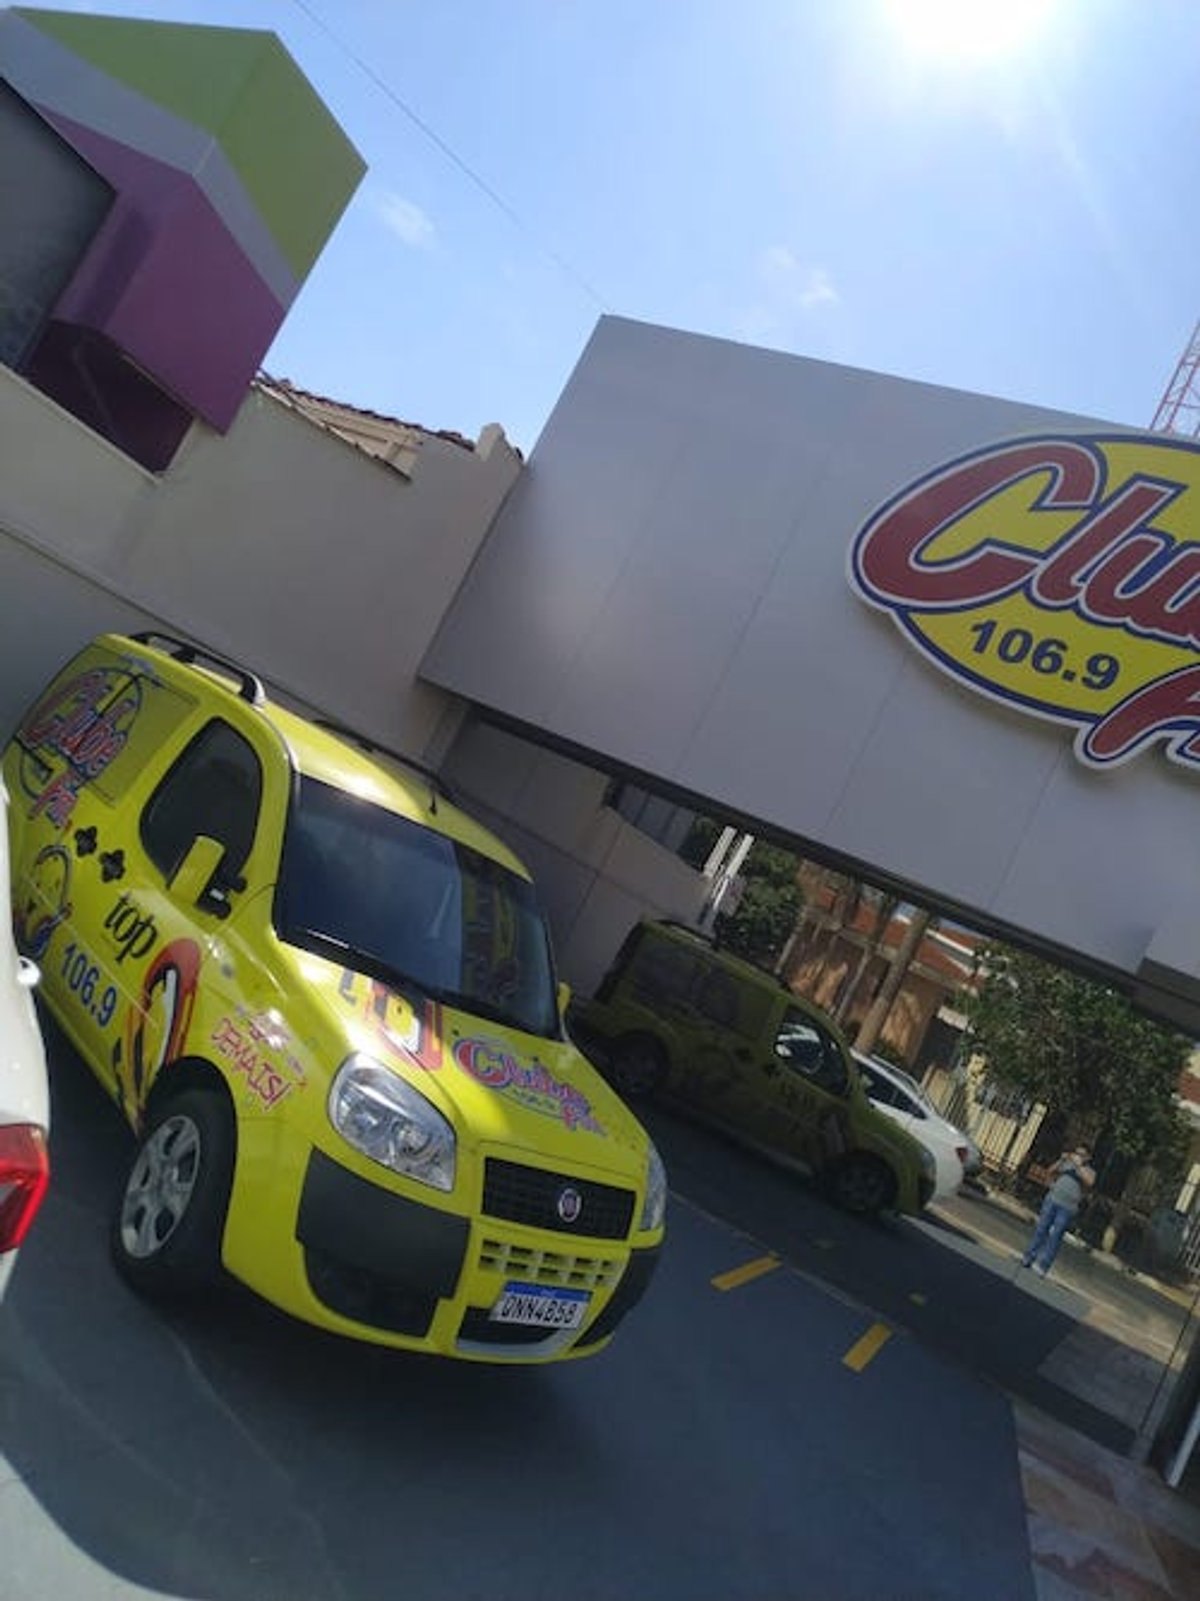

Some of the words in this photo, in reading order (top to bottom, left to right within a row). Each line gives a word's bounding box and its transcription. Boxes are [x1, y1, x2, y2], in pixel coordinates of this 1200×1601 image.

[970, 619, 1121, 691] 106.9
[104, 892, 158, 964] top
[60, 942, 118, 1029] 106.9
